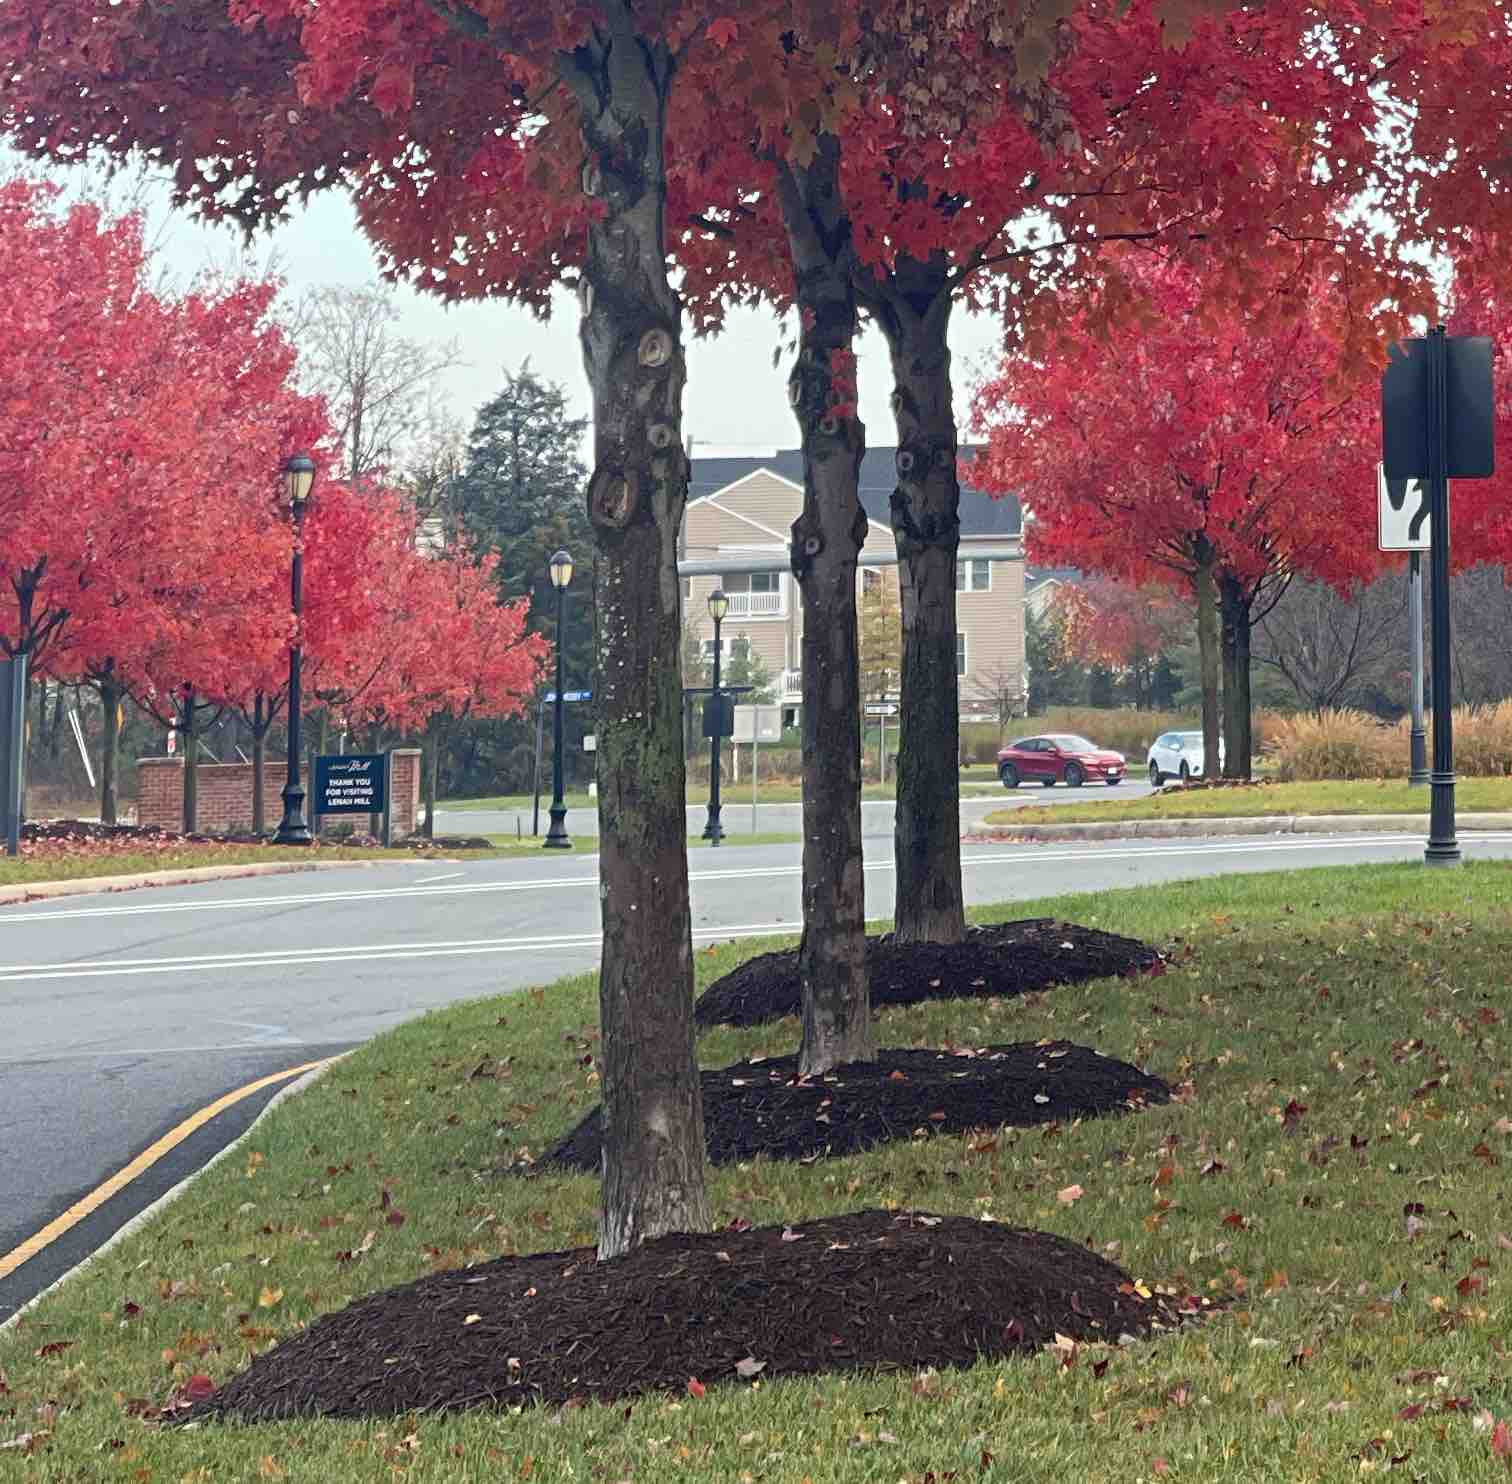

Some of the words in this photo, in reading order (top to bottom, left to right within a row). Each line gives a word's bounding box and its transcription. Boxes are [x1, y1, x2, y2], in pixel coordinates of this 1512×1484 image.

[329, 778, 353, 786] THANK
[355, 778, 371, 786] YOU
[325, 788, 341, 796] FOR
[342, 787, 373, 796] VISITING
